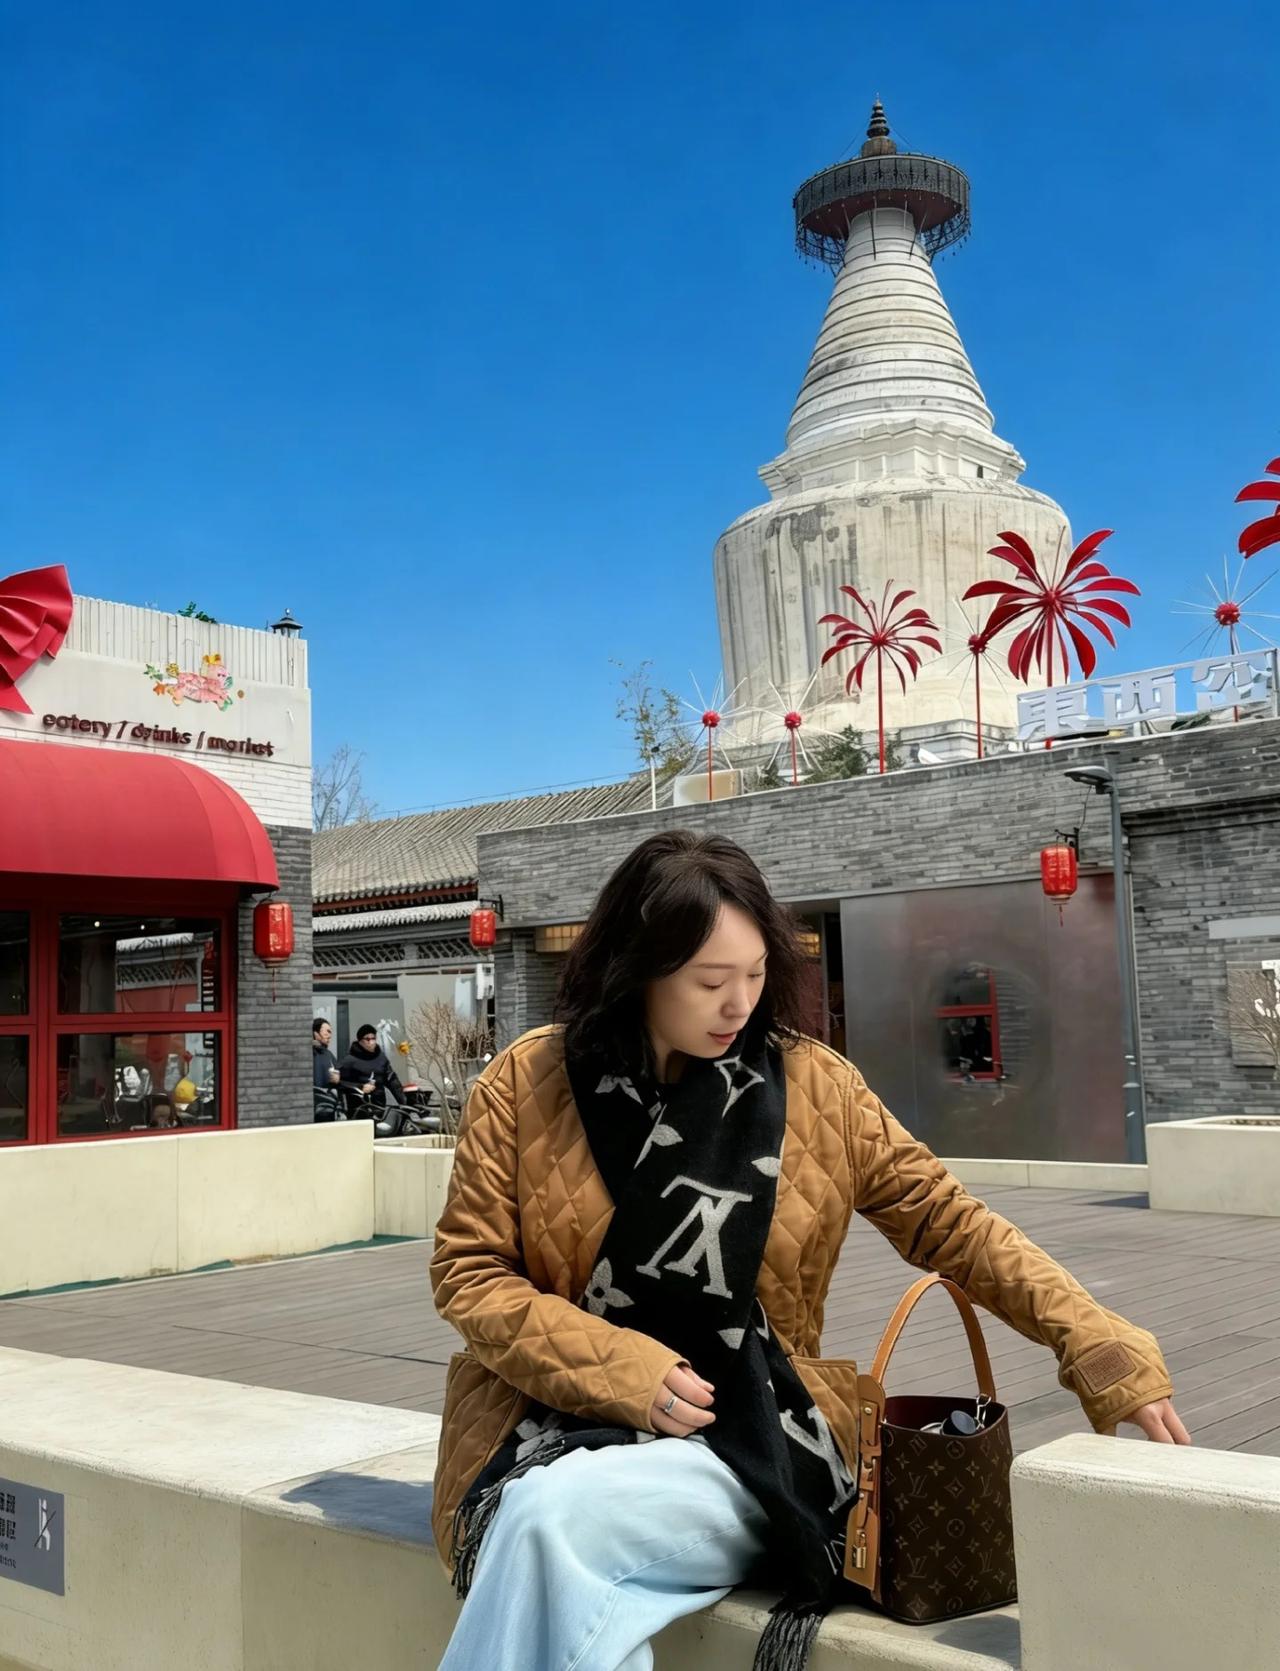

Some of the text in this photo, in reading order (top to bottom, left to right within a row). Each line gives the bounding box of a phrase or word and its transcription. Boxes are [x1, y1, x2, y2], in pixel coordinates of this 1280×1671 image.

[42, 712, 110, 739] eatery
[131, 722, 191, 745] drinks
[207, 735, 274, 758] market
